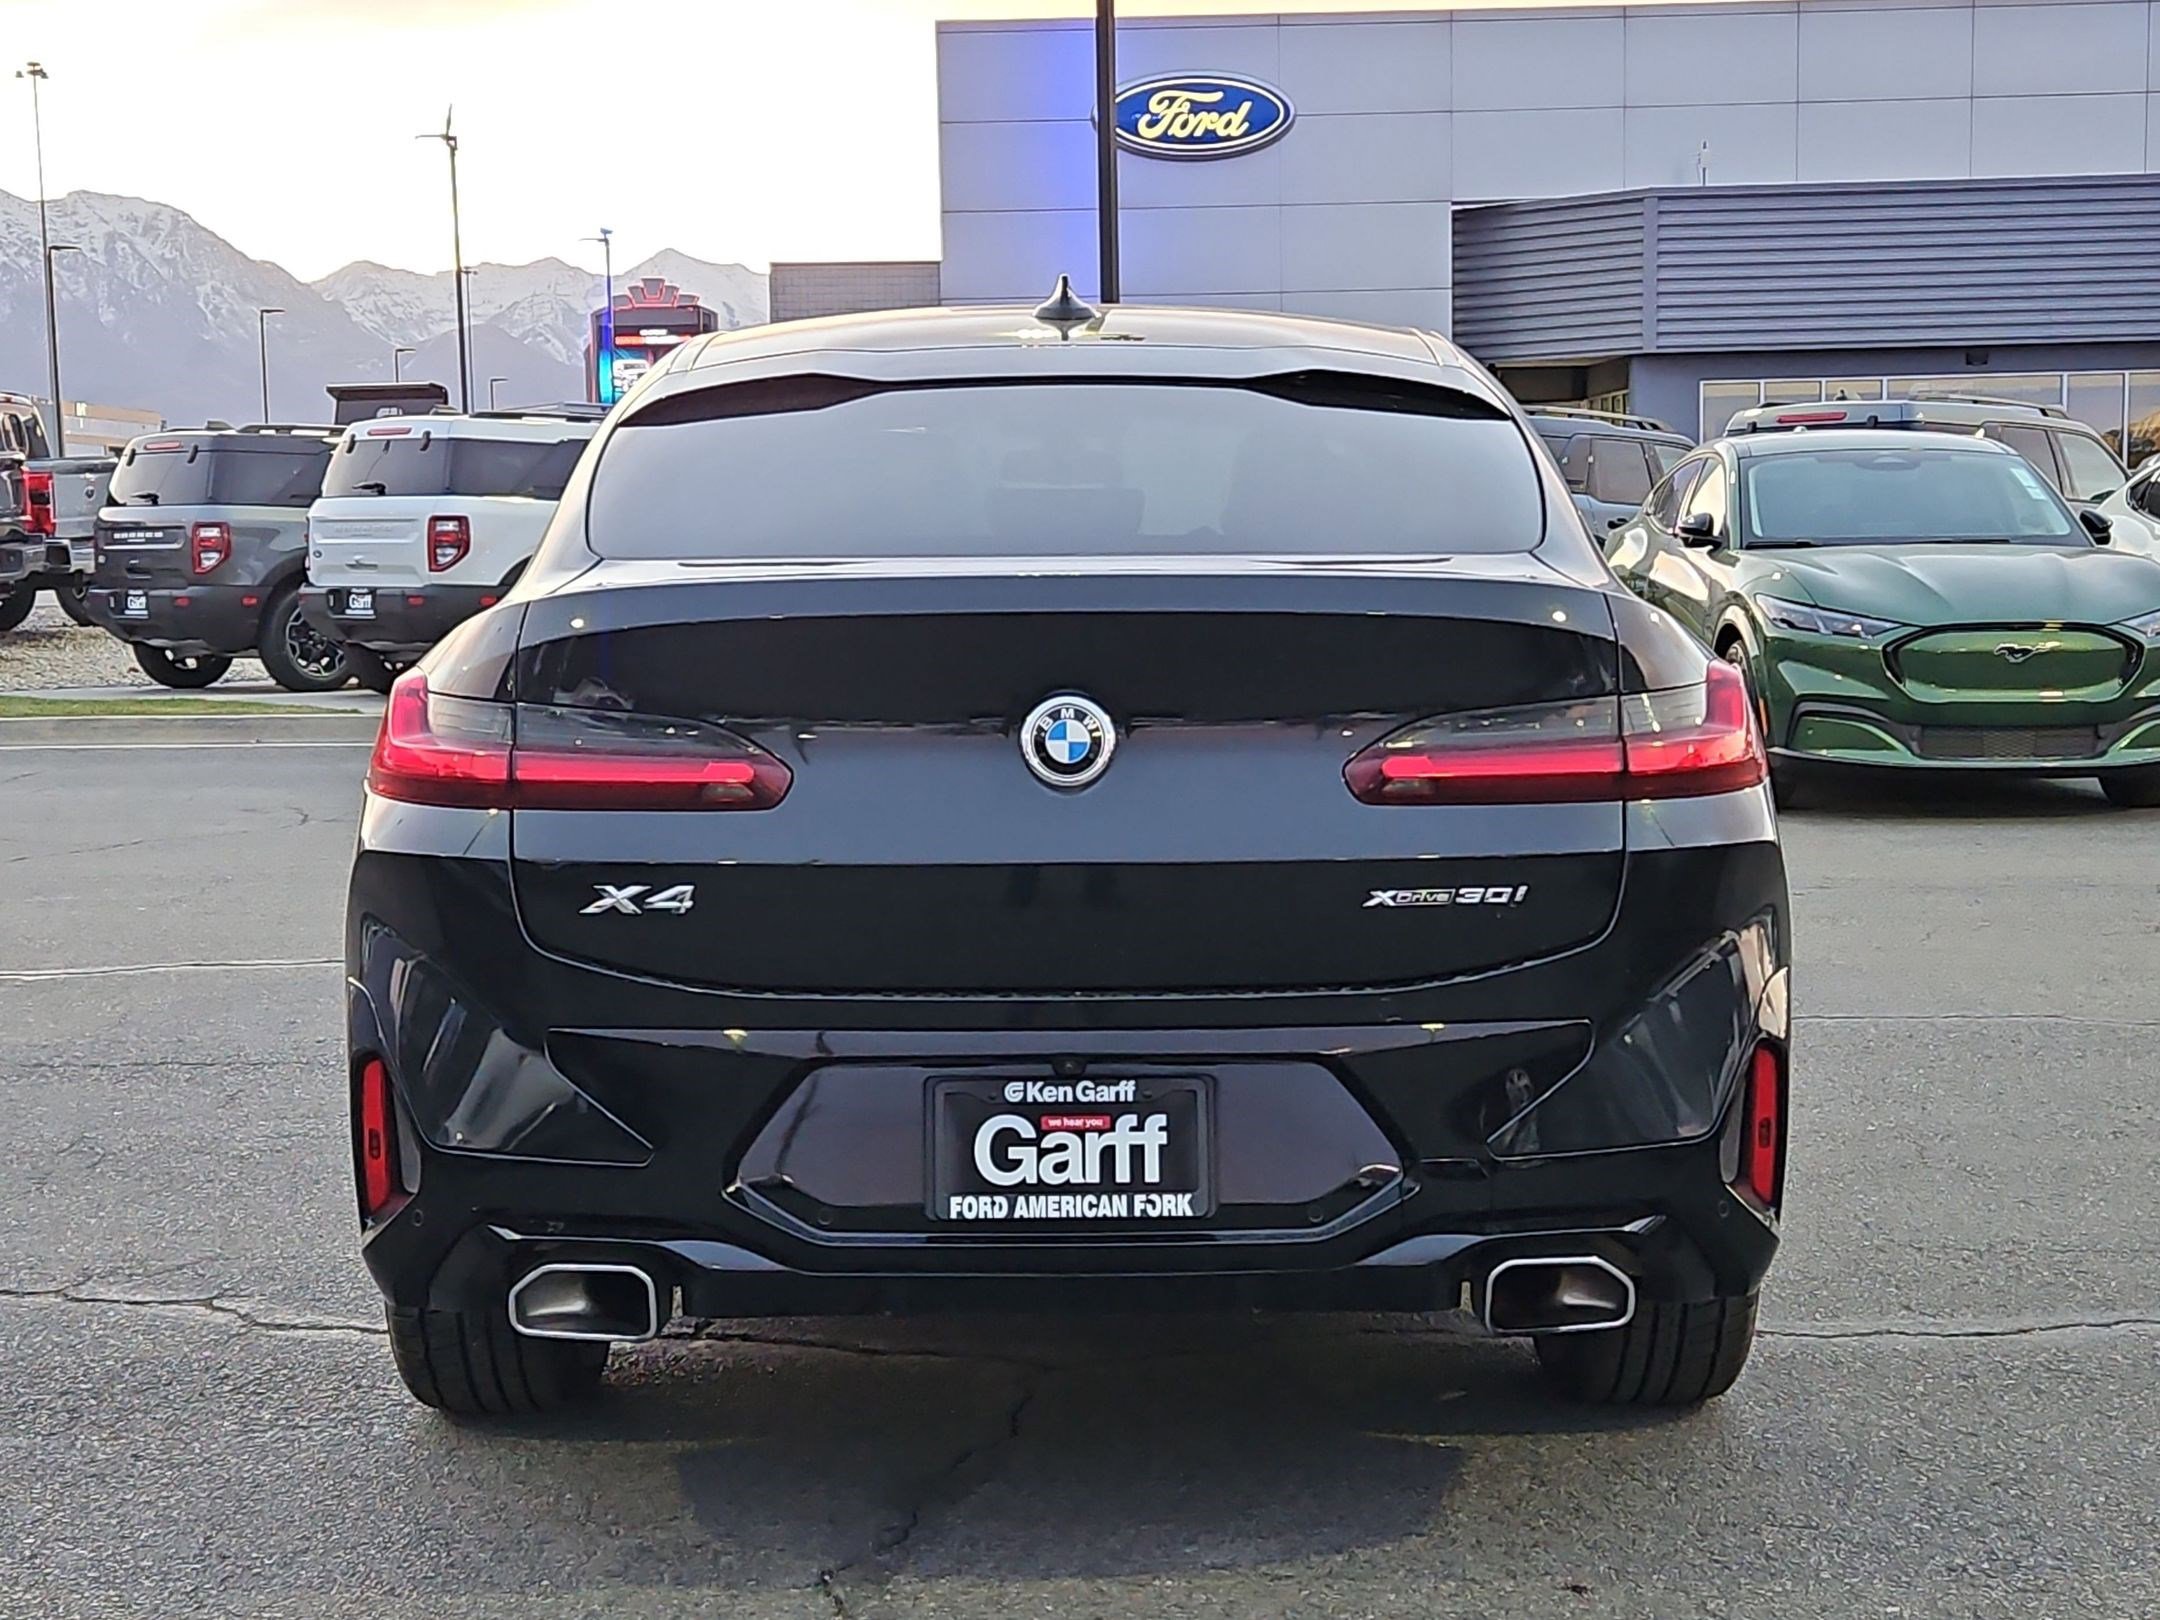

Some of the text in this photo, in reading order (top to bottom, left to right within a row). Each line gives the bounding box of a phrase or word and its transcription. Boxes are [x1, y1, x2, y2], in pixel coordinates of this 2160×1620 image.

[1137, 90, 1253, 139] Ford
[1039, 707, 1098, 731] BMW
[578, 885, 695, 914] X4
[1027, 1080, 1136, 1102] Ken Garff
[1048, 1117, 1104, 1129] we hear you
[973, 1113, 1168, 1186] Garff
[950, 1193, 1193, 1219] FORD AMERICAN FORK
